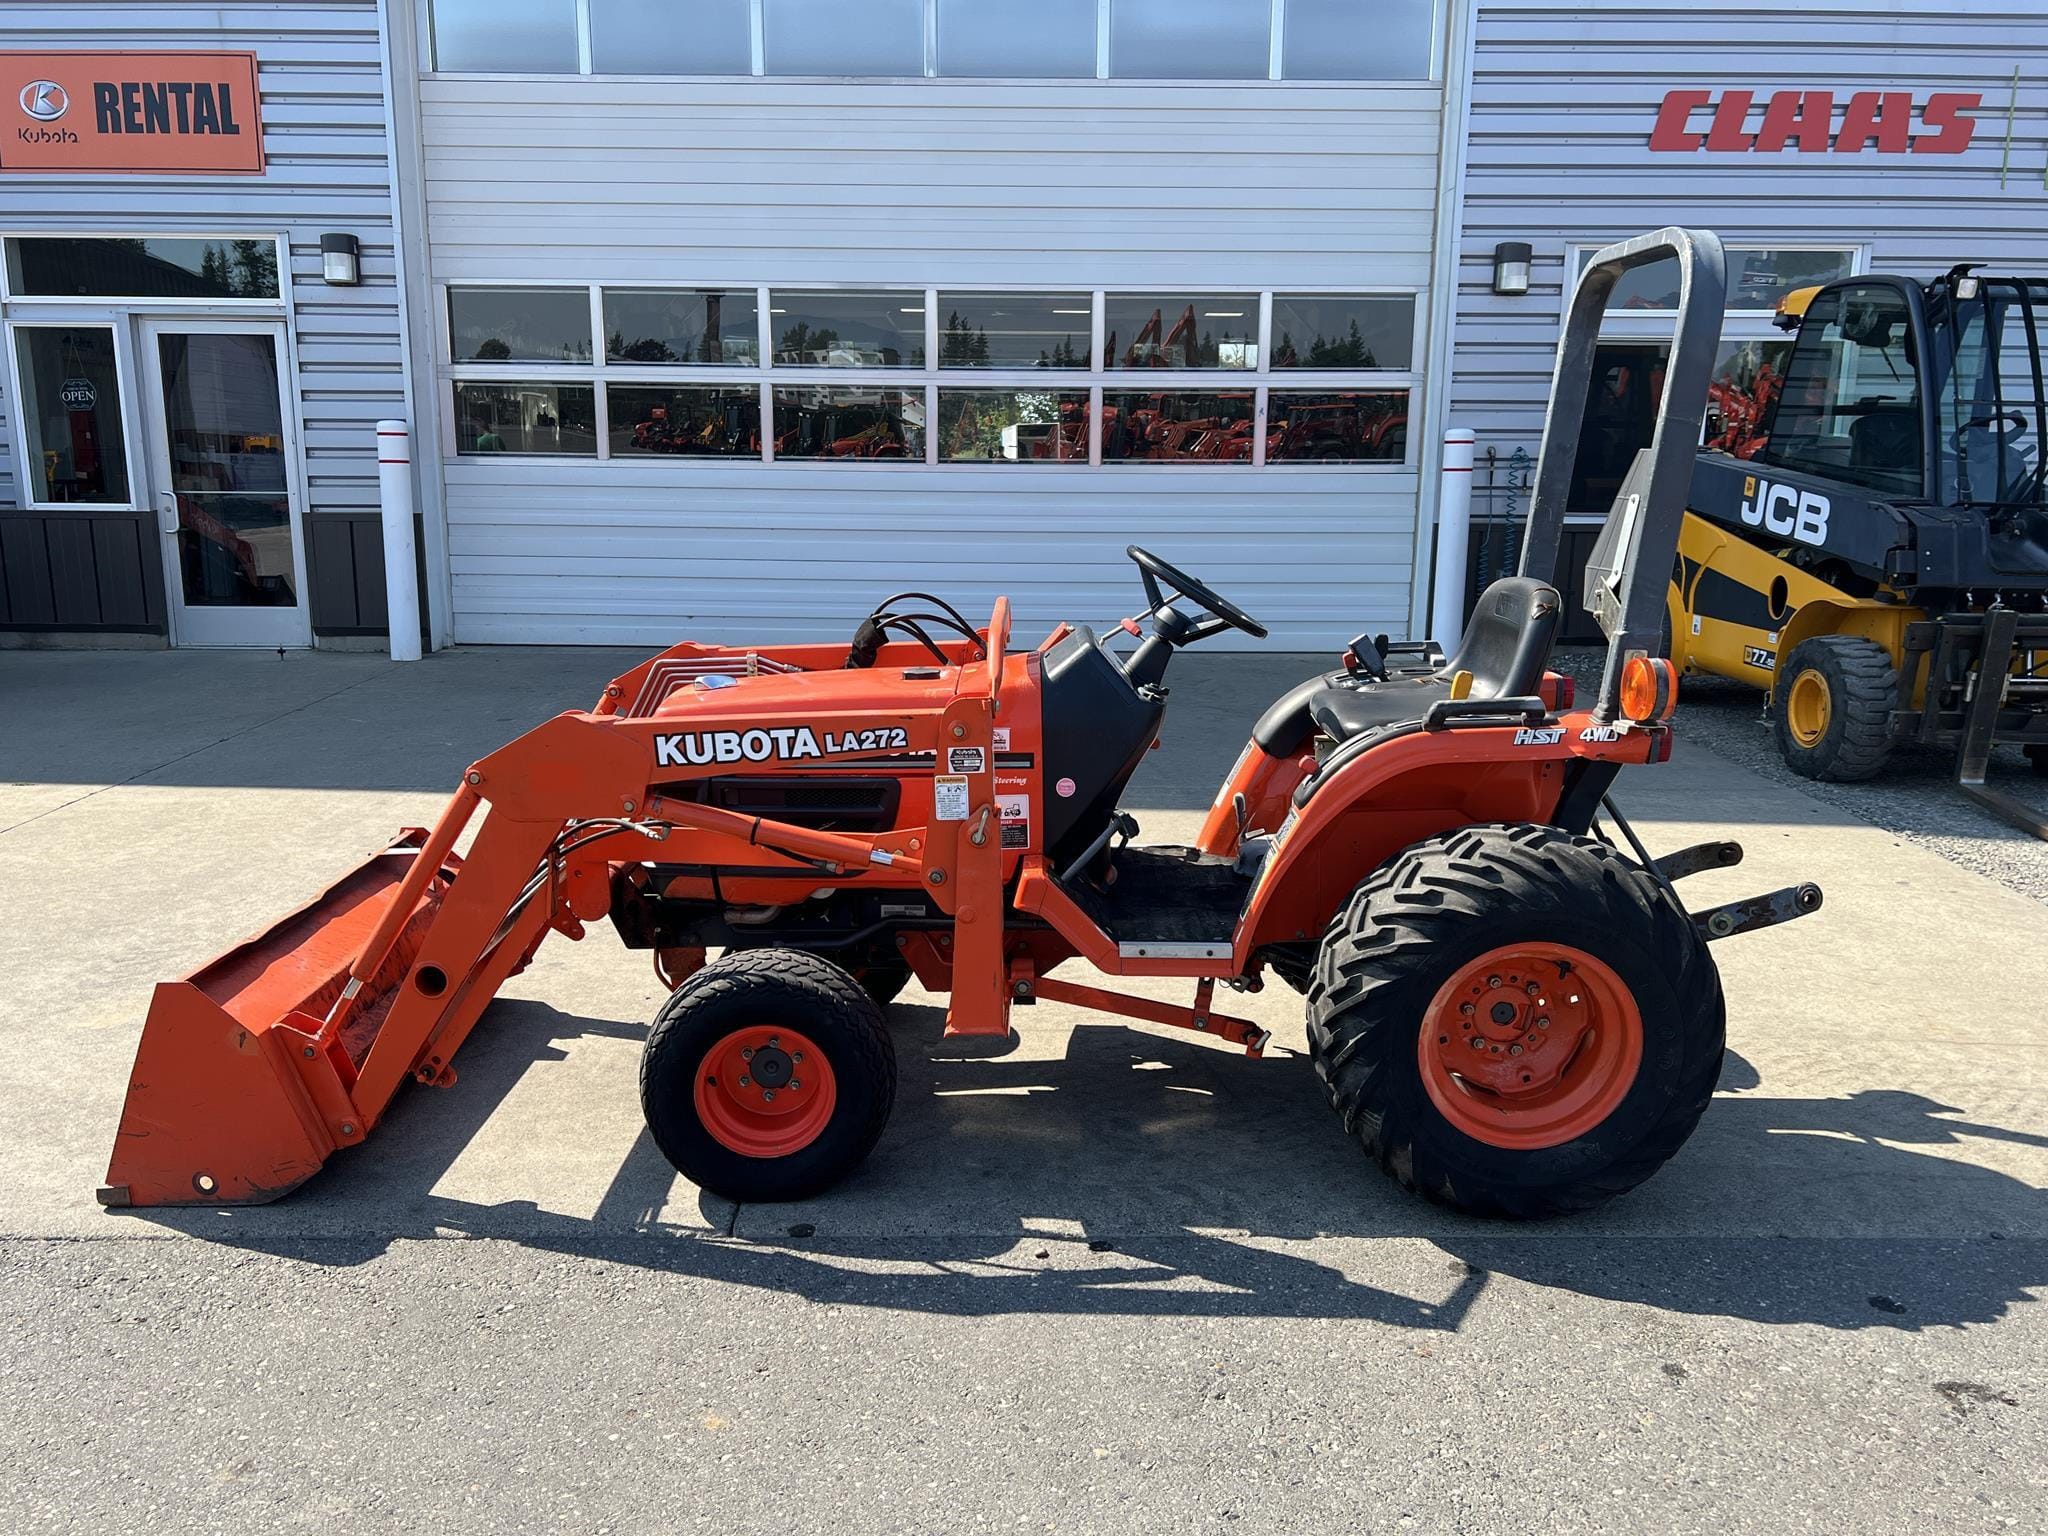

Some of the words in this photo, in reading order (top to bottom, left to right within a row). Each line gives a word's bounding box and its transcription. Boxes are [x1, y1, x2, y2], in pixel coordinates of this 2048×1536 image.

[93, 82, 240, 135] RENTAL
[1648, 91, 1983, 153] CLAAS
[18, 127, 79, 144] Kubota
[62, 391, 94, 401] OPEN
[1741, 480, 1830, 546] JCB
[655, 728, 822, 766] KUBOTA
[824, 728, 907, 753] LA272
[1514, 728, 1567, 745] HST
[1580, 727, 1619, 742] 4WD
